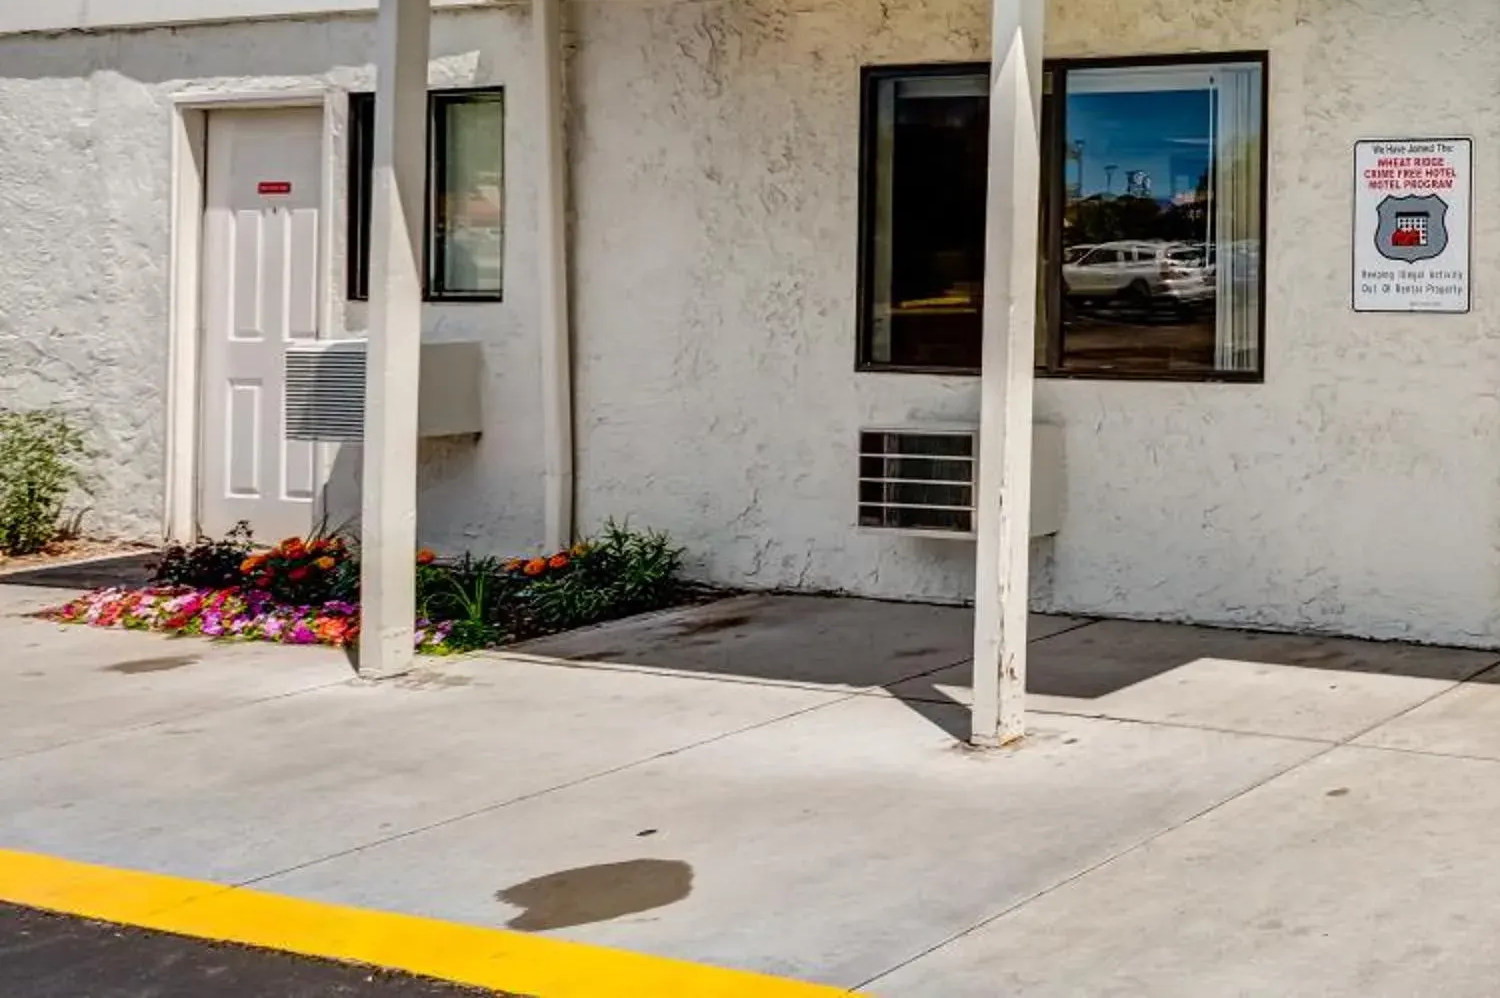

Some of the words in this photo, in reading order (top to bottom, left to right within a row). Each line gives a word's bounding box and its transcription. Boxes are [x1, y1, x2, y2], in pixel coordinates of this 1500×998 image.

[1386, 144, 1406, 154] Have
[1377, 157, 1411, 167] WHEAT
[1414, 157, 1444, 167] RIDGE
[1364, 169, 1394, 179] CRIME
[1397, 169, 1422, 179] FREE
[1425, 168, 1456, 178] HOTEL
[1368, 180, 1400, 189] MOTEL
[1404, 179, 1453, 189] PROGRAM
[1361, 283, 1377, 294] Out
